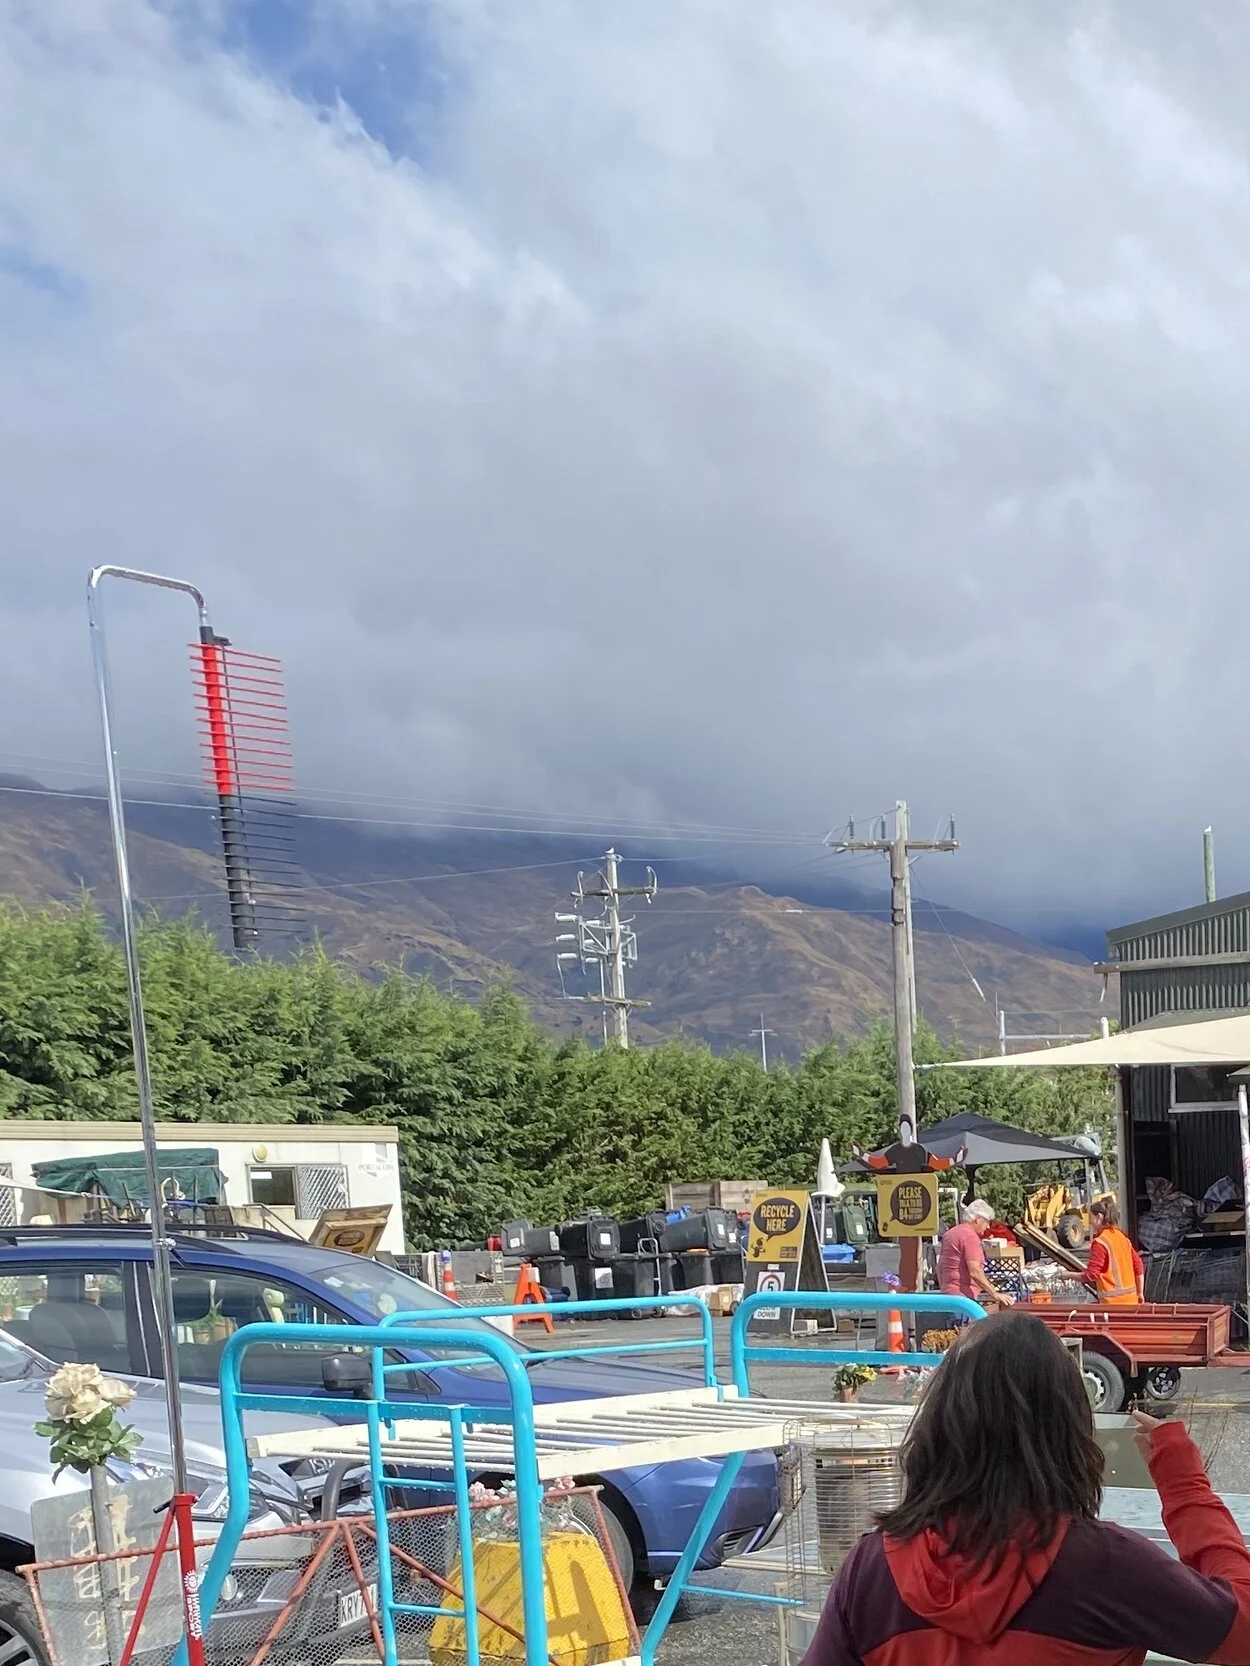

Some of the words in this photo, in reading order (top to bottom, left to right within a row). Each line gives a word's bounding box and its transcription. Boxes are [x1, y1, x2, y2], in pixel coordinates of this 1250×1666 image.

[898, 1186, 922, 1199] PLEASE
[760, 1204, 795, 1218] RECYCLE
[766, 1218, 787, 1231] HERE
[757, 1311, 777, 1319] DOWN
